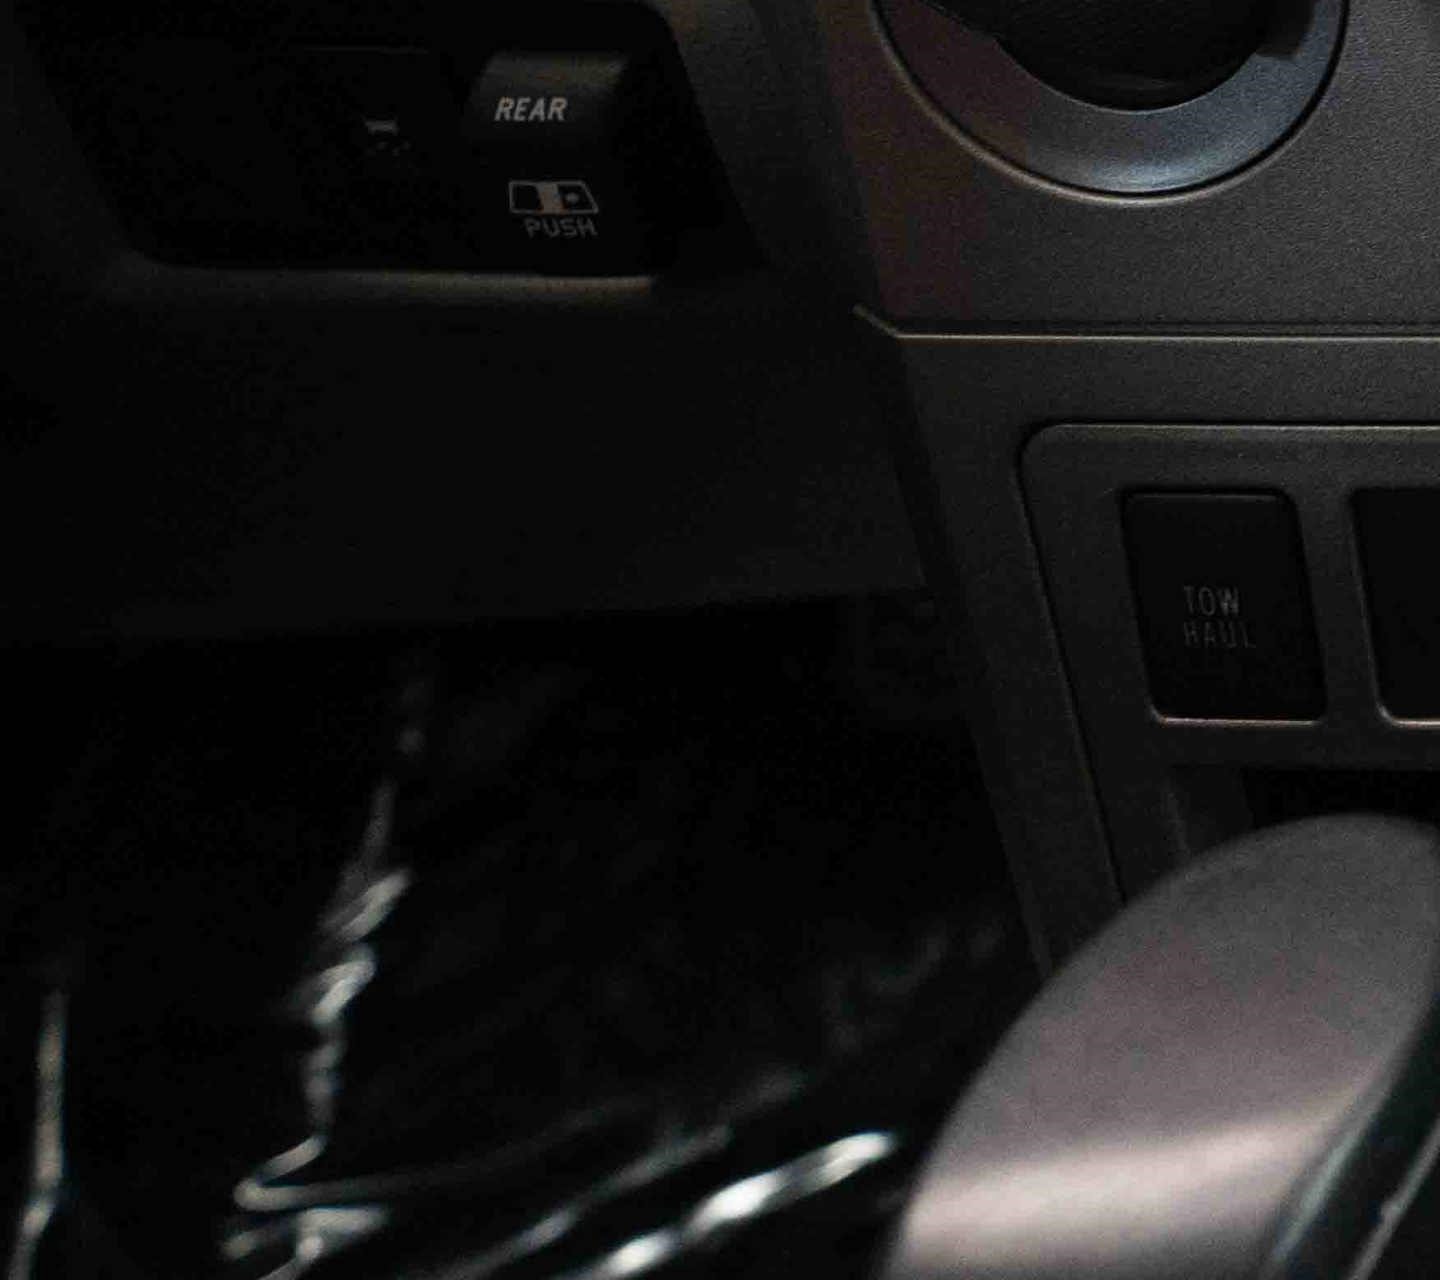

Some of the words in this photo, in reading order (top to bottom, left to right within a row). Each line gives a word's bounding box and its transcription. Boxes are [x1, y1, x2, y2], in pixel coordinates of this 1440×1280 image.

[494, 96, 569, 124] REAR
[524, 215, 598, 240] PUSH
[1183, 585, 1241, 617] TOW
